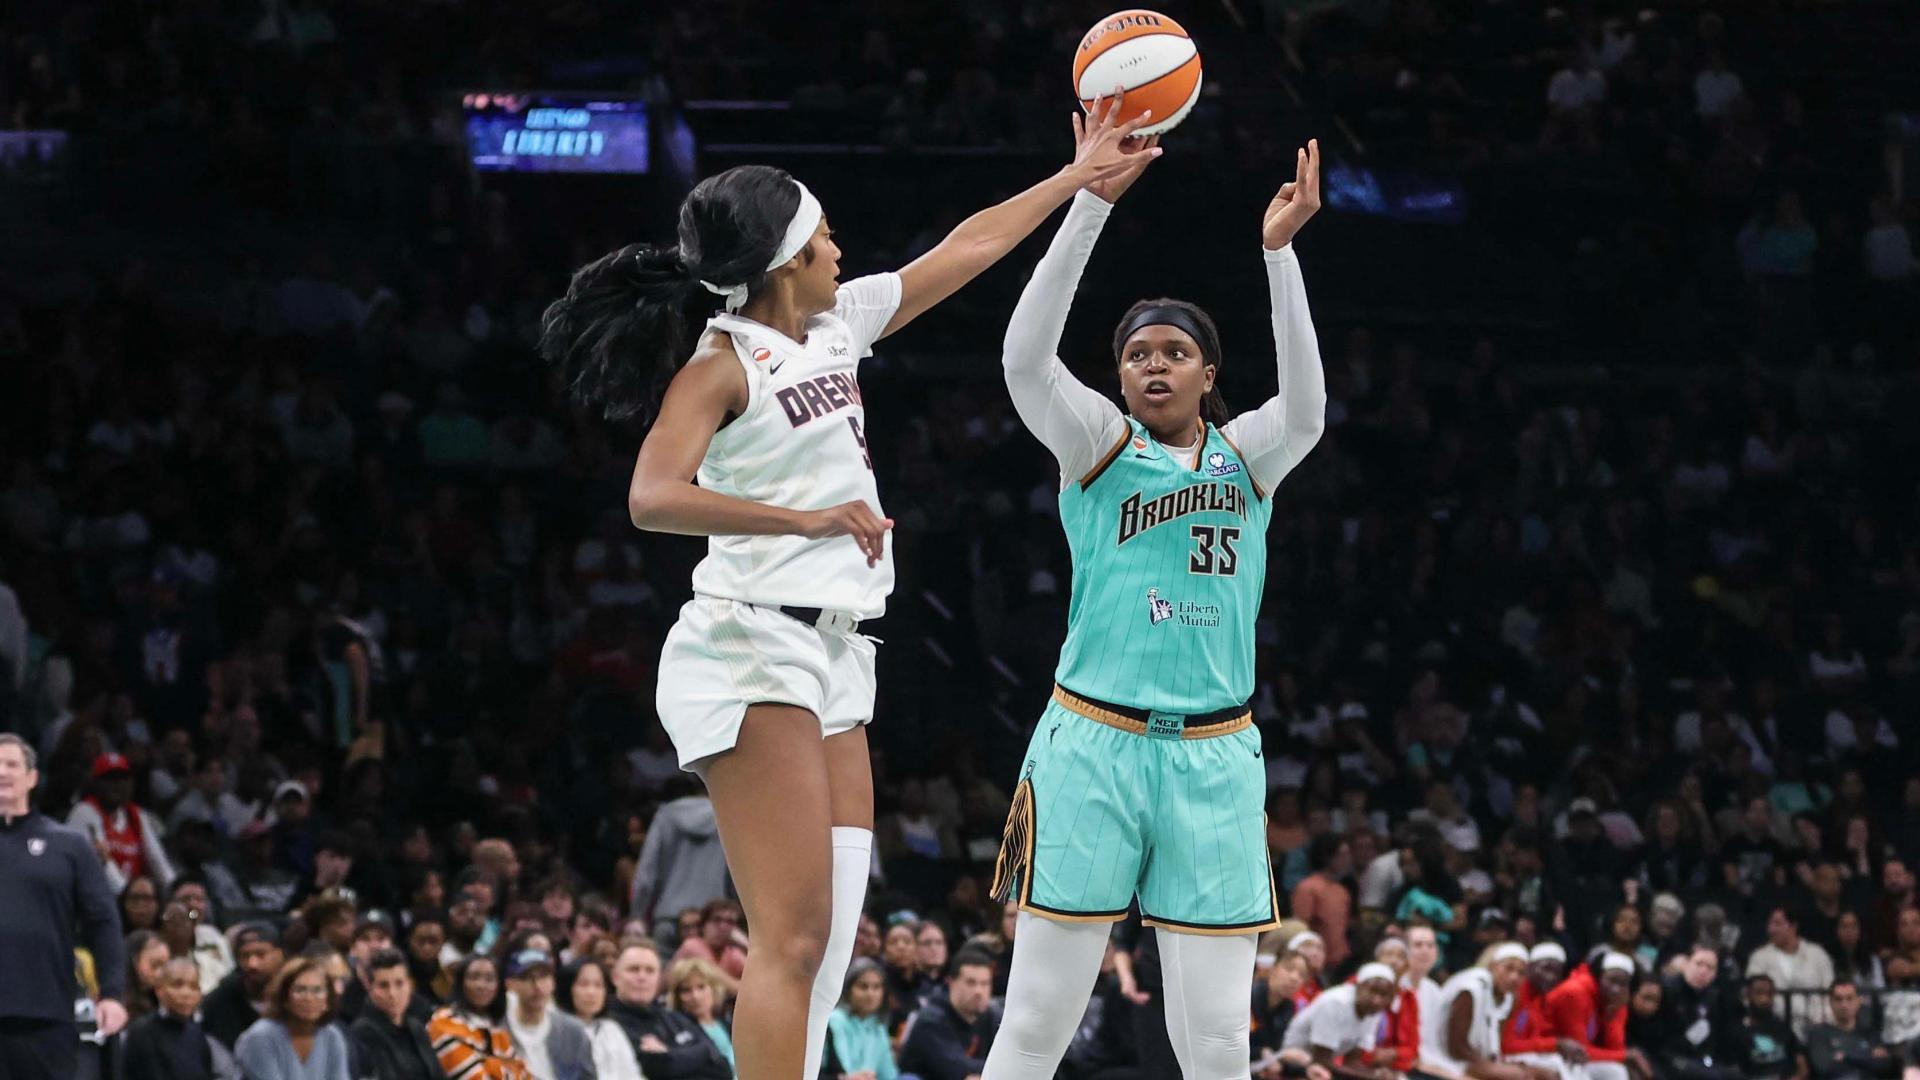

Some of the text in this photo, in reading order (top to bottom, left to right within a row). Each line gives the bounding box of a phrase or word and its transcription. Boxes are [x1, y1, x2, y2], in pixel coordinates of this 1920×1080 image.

[1206, 464, 1239, 476] ARCLAYS
[1189, 523, 1241, 577] 35
[1178, 601, 1220, 615] Liberty
[1177, 614, 1220, 628] Mutual
[1155, 718, 1179, 728] NEW
